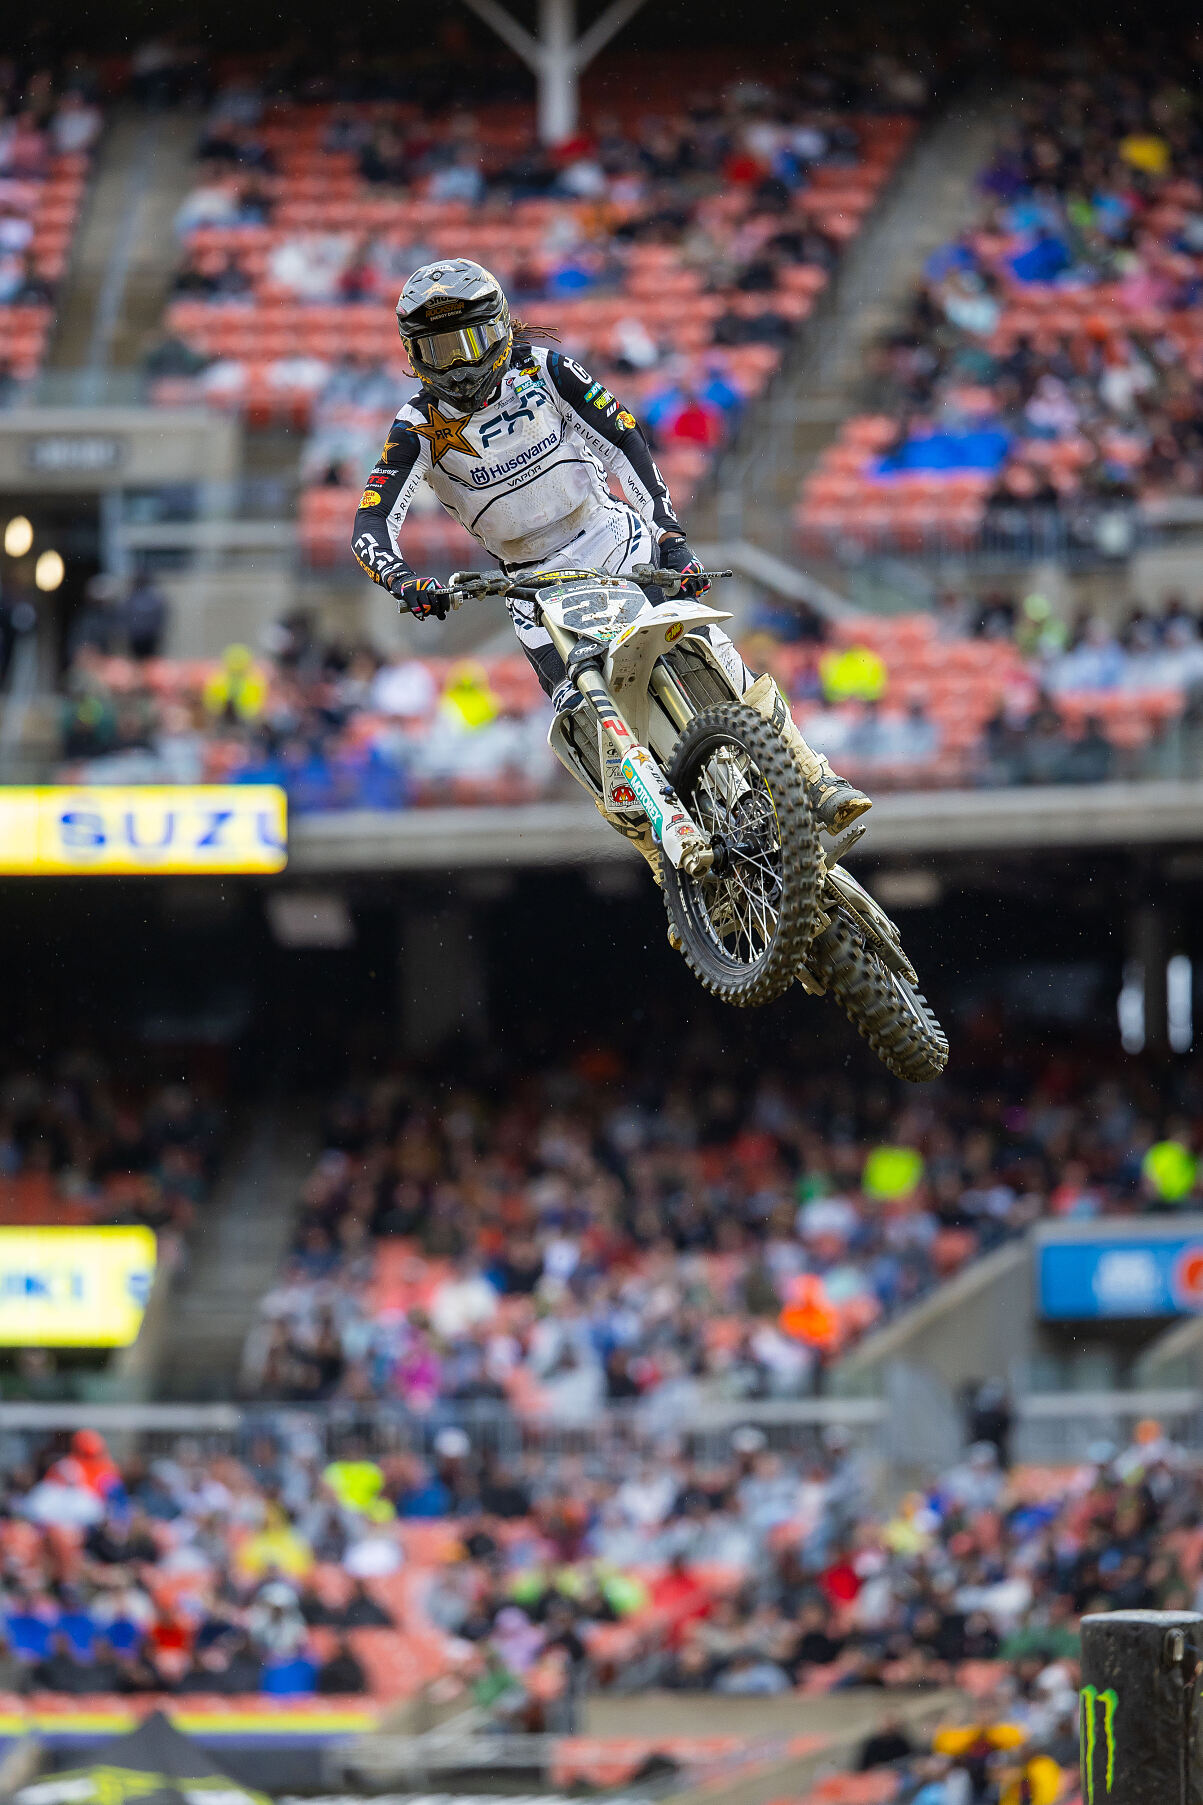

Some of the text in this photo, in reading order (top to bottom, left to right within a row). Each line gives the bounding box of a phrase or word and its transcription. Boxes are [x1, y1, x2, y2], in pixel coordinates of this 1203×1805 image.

[425, 302, 465, 318] ROCKSTAR
[489, 432, 558, 479] Husqvarna
[573, 423, 610, 457] RIVELL
[507, 464, 542, 487] VAPOR
[561, 591, 646, 630] 27
[630, 775, 663, 825] MOTOREX
